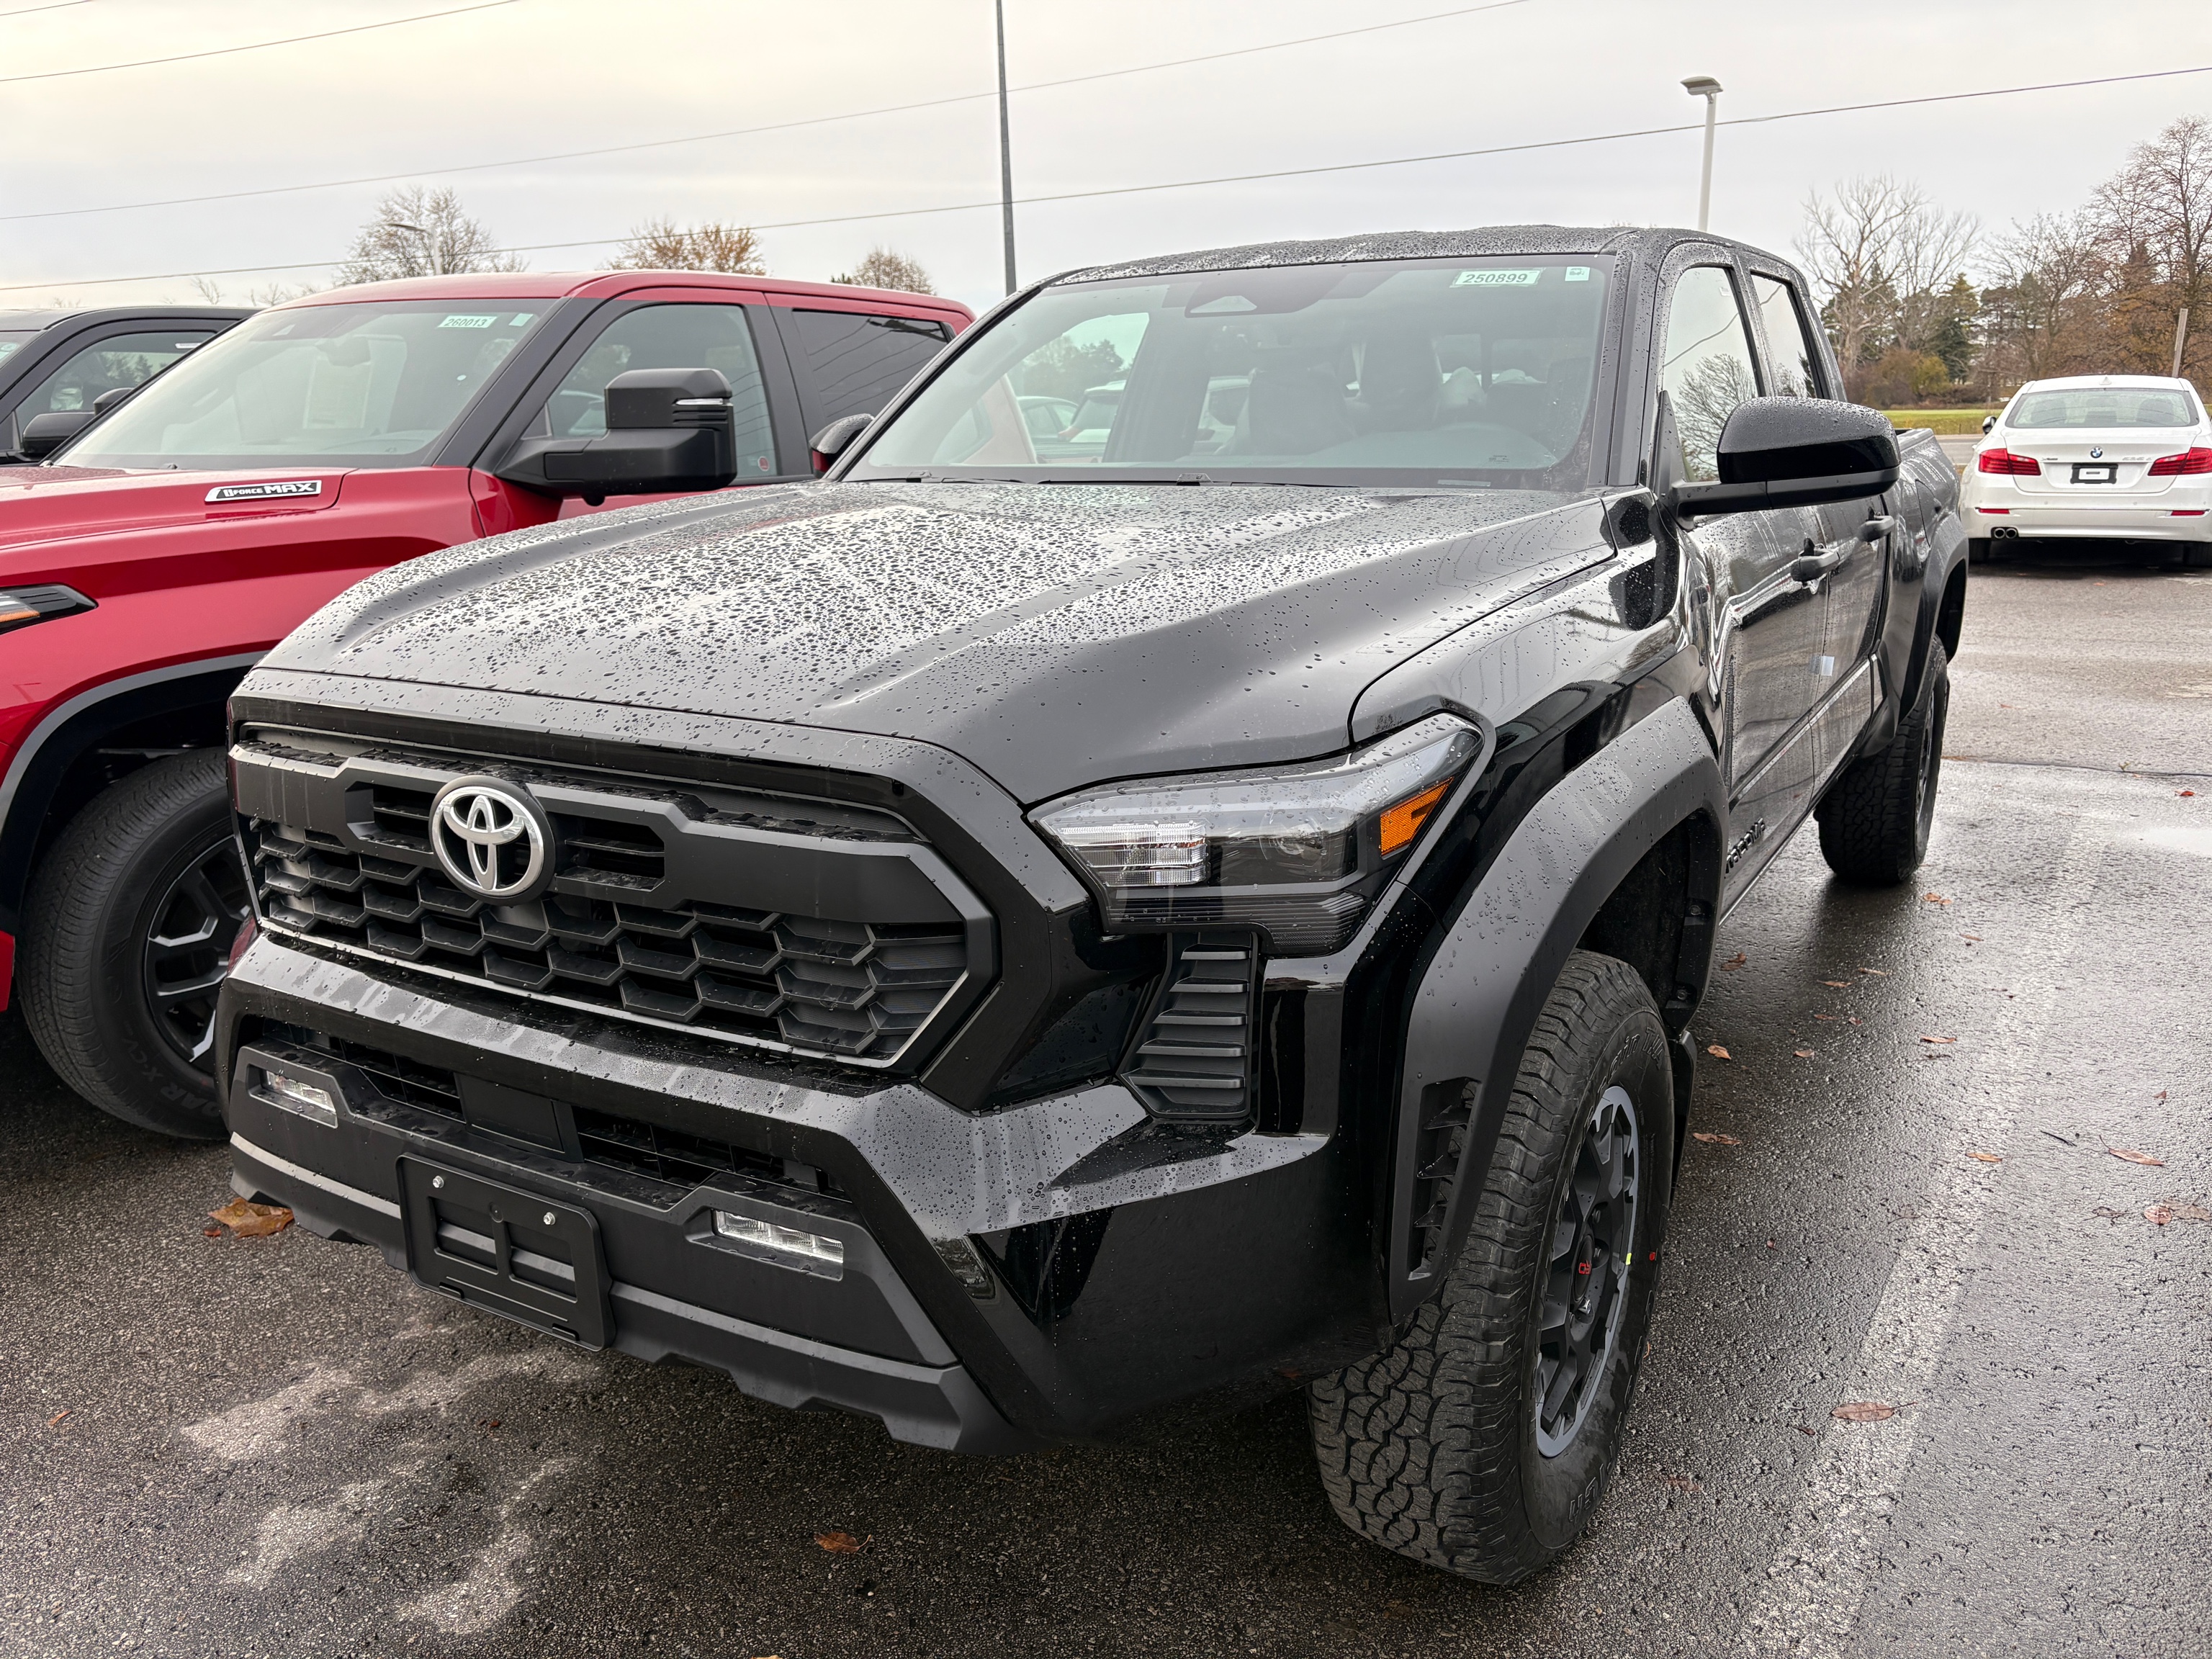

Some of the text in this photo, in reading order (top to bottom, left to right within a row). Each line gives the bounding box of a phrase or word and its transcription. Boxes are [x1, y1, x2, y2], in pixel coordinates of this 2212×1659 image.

[1462, 273, 1528, 283] 250899
[444, 318, 488, 327] 260013
[264, 482, 315, 495] MAX
